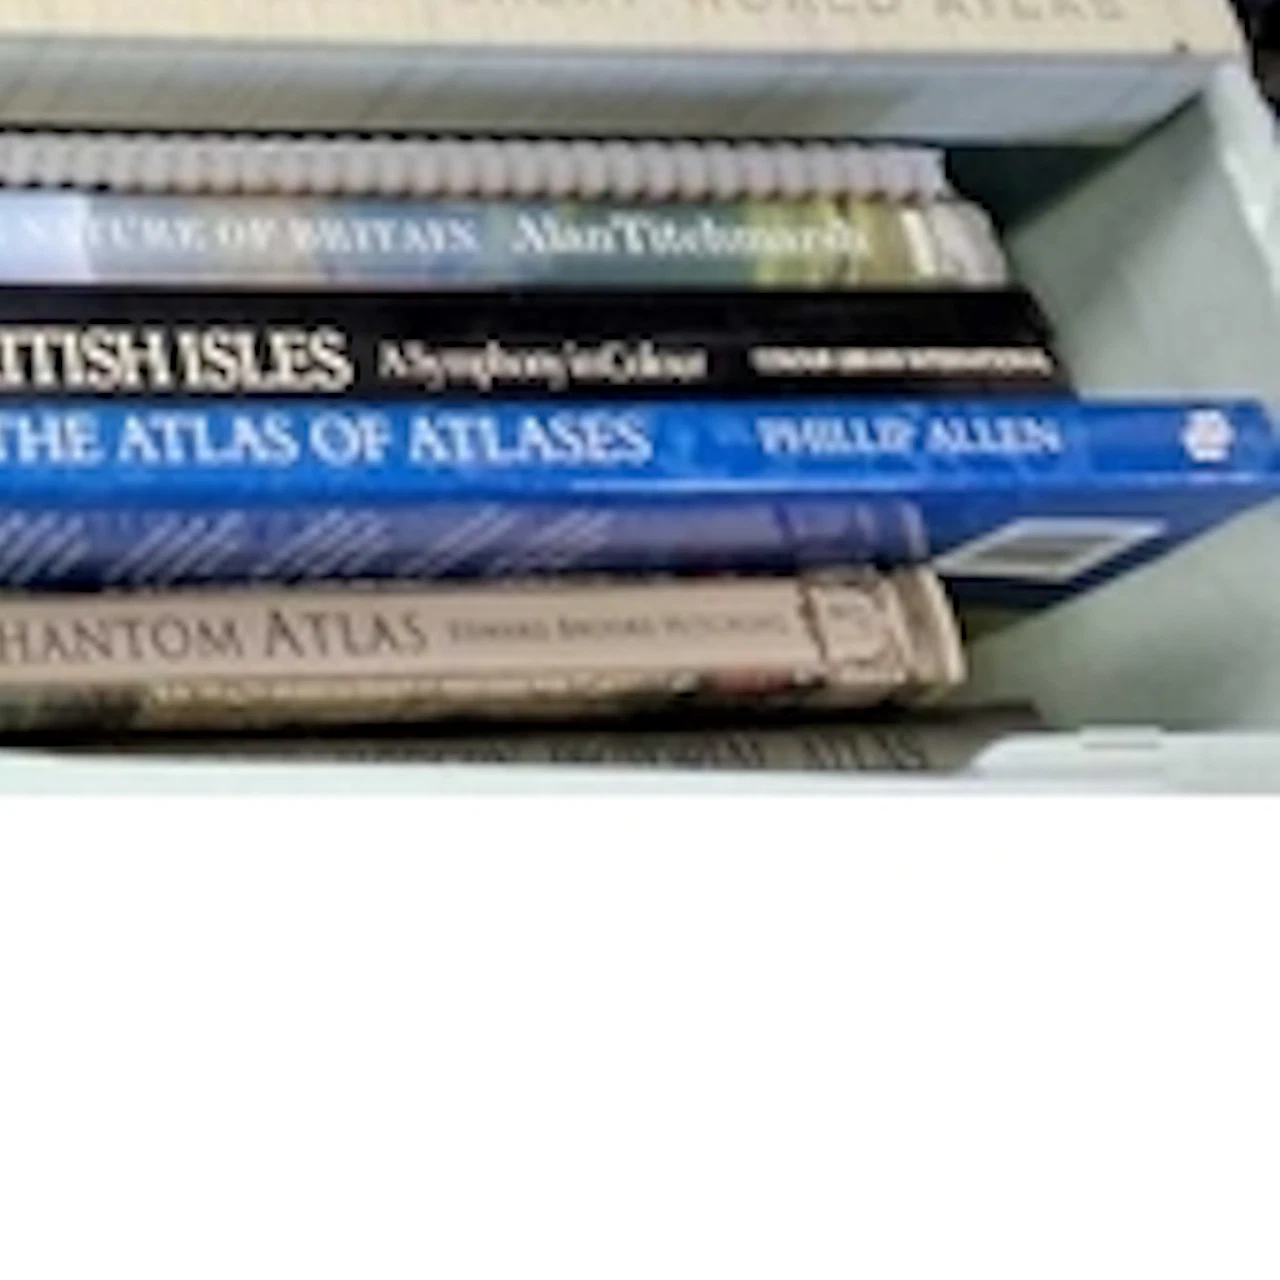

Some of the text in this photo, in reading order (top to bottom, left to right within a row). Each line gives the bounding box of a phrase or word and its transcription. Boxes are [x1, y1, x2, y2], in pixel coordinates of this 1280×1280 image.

[293, 217, 480, 257] BRITAIN
[172, 326, 354, 392] ISLES
[115, 413, 300, 467] ATLAS
[307, 415, 395, 468] OF
[408, 412, 656, 468] ATLASES
[754, 414, 922, 460] PHILLIP
[926, 415, 1065, 460] ALLEN
[263, 608, 432, 661] ATLAS
